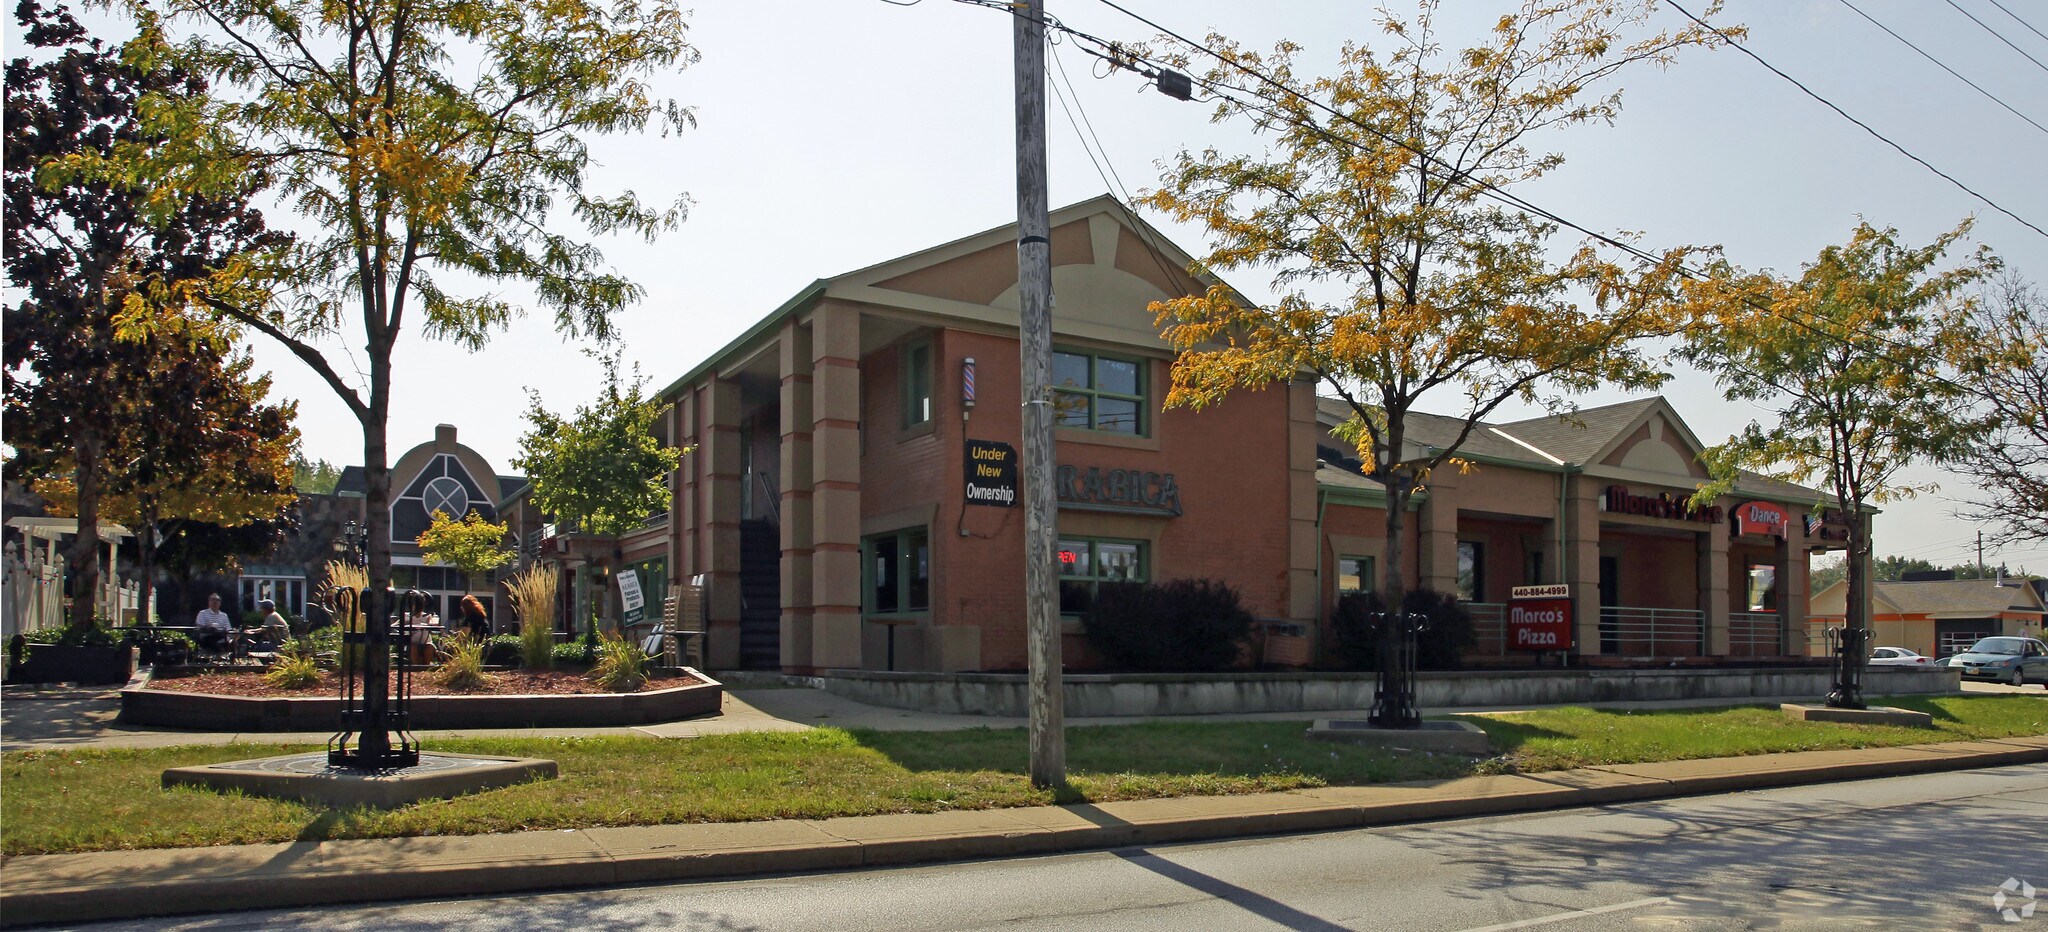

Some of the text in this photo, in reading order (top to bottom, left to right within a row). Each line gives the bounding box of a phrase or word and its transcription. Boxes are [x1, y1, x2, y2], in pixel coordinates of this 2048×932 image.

[972, 446, 1006, 461] Under
[977, 463, 1002, 477] New
[966, 482, 1015, 505] Ownership
[1057, 464, 1182, 515] RABICA
[1751, 506, 1780, 524] Dance
[1057, 551, 1077, 563] PEN
[1514, 586, 1567, 597] 440-884-4999
[1511, 606, 1564, 624] Marco's
[1518, 628, 1556, 645] Pizza
